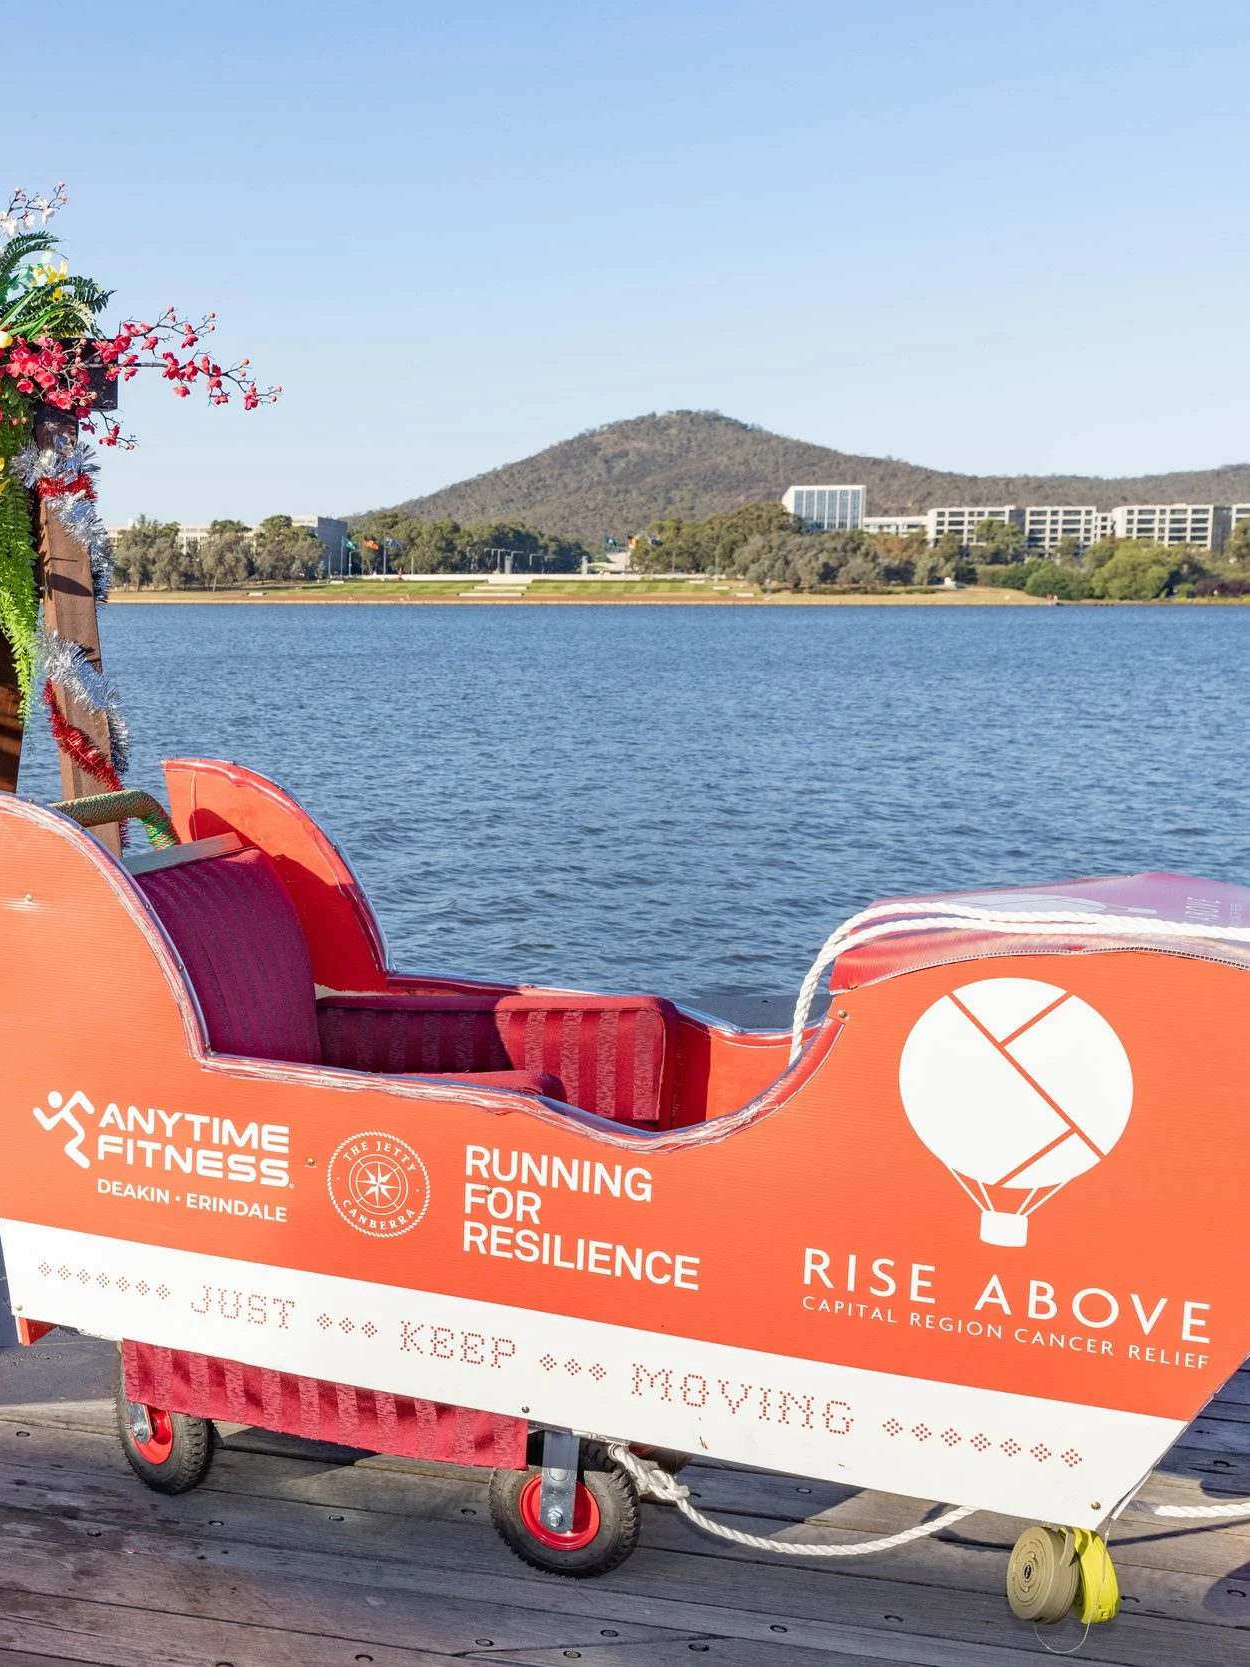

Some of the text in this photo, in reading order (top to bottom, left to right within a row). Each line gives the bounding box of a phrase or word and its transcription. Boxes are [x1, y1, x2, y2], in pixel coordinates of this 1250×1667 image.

[98, 1102, 290, 1154] ANYTIME
[97, 1134, 291, 1189] FITNESS
[342, 1140, 417, 1172] THE JETTY
[465, 1144, 653, 1203] RUNNING
[97, 1178, 288, 1223] DEAKIN ERINDALE
[342, 1199, 416, 1230] CANBERRA
[464, 1182, 542, 1225] FOR
[463, 1220, 701, 1291] RESILIENCE
[802, 1247, 1211, 1344] RISE ABOVE
[190, 1286, 854, 1435] JUST KEEP MOVING
[802, 1296, 1210, 1370] CAPITAL REGION CANCER RELIEF
